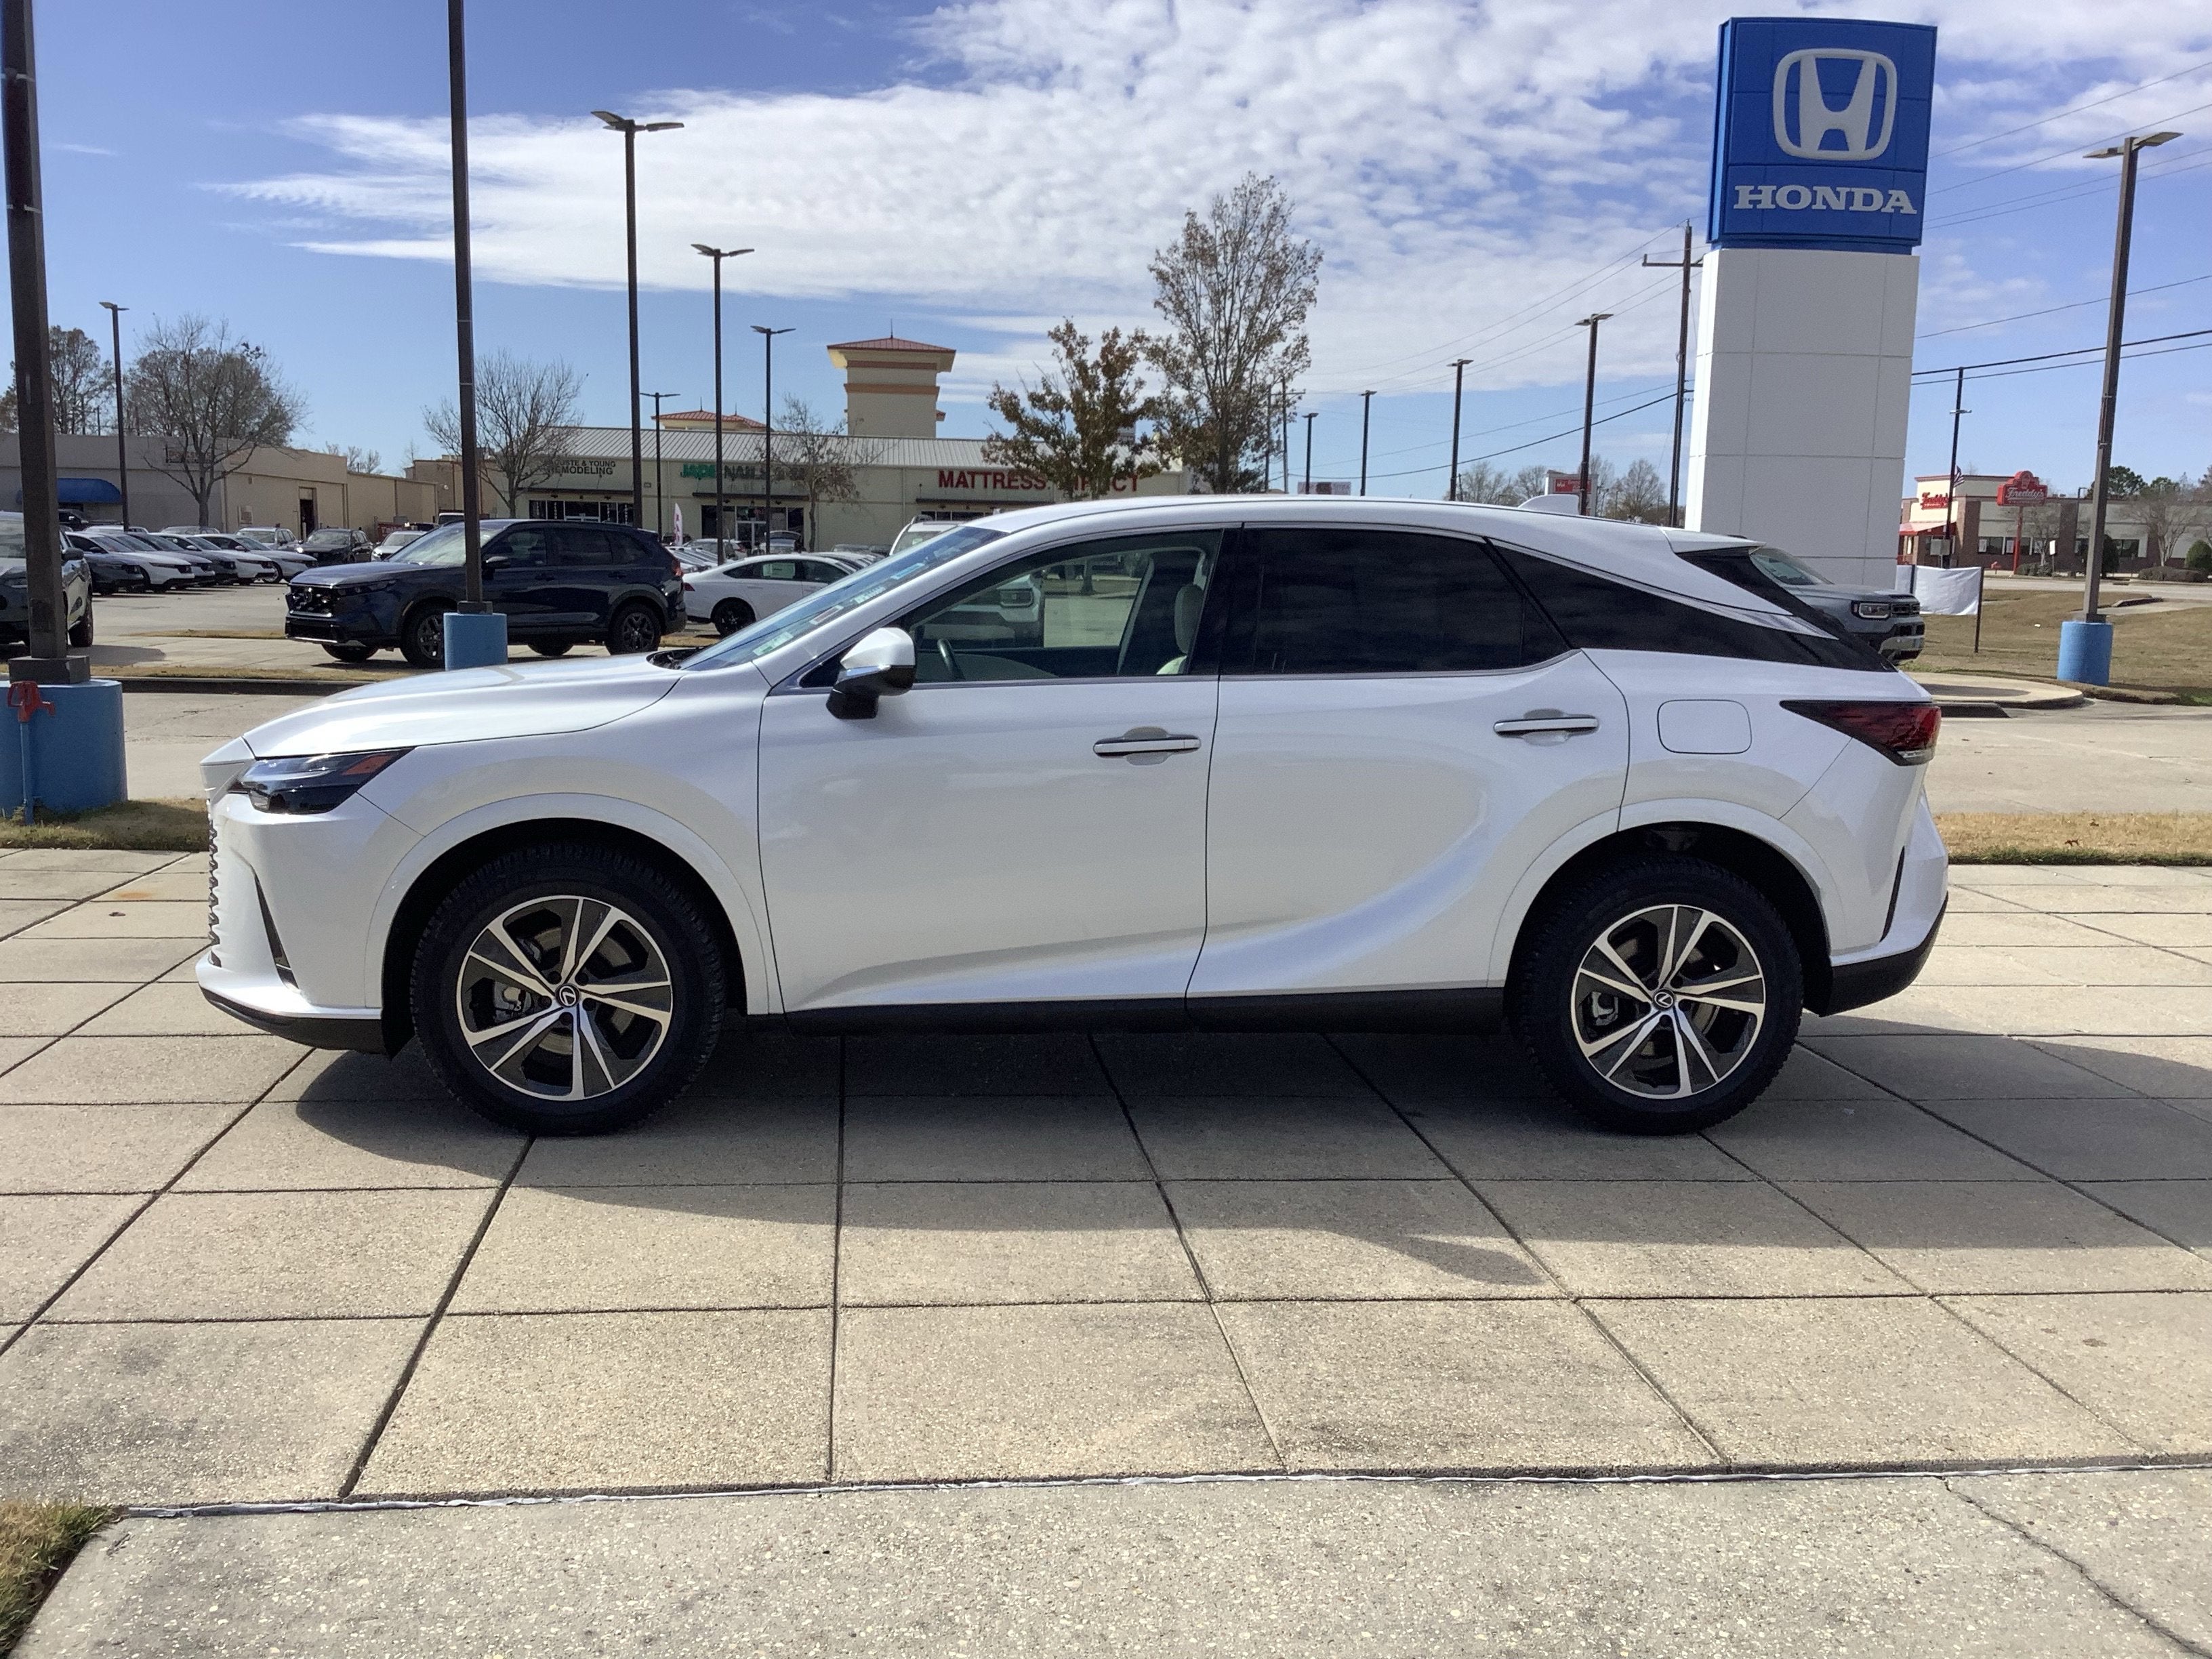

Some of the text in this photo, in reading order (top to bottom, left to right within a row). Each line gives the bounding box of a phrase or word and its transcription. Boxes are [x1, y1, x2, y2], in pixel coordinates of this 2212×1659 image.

[1734, 185, 1917, 215] HONDA
[938, 470, 1046, 490] MATTRESS
[2005, 487, 2045, 499] Freddy's
